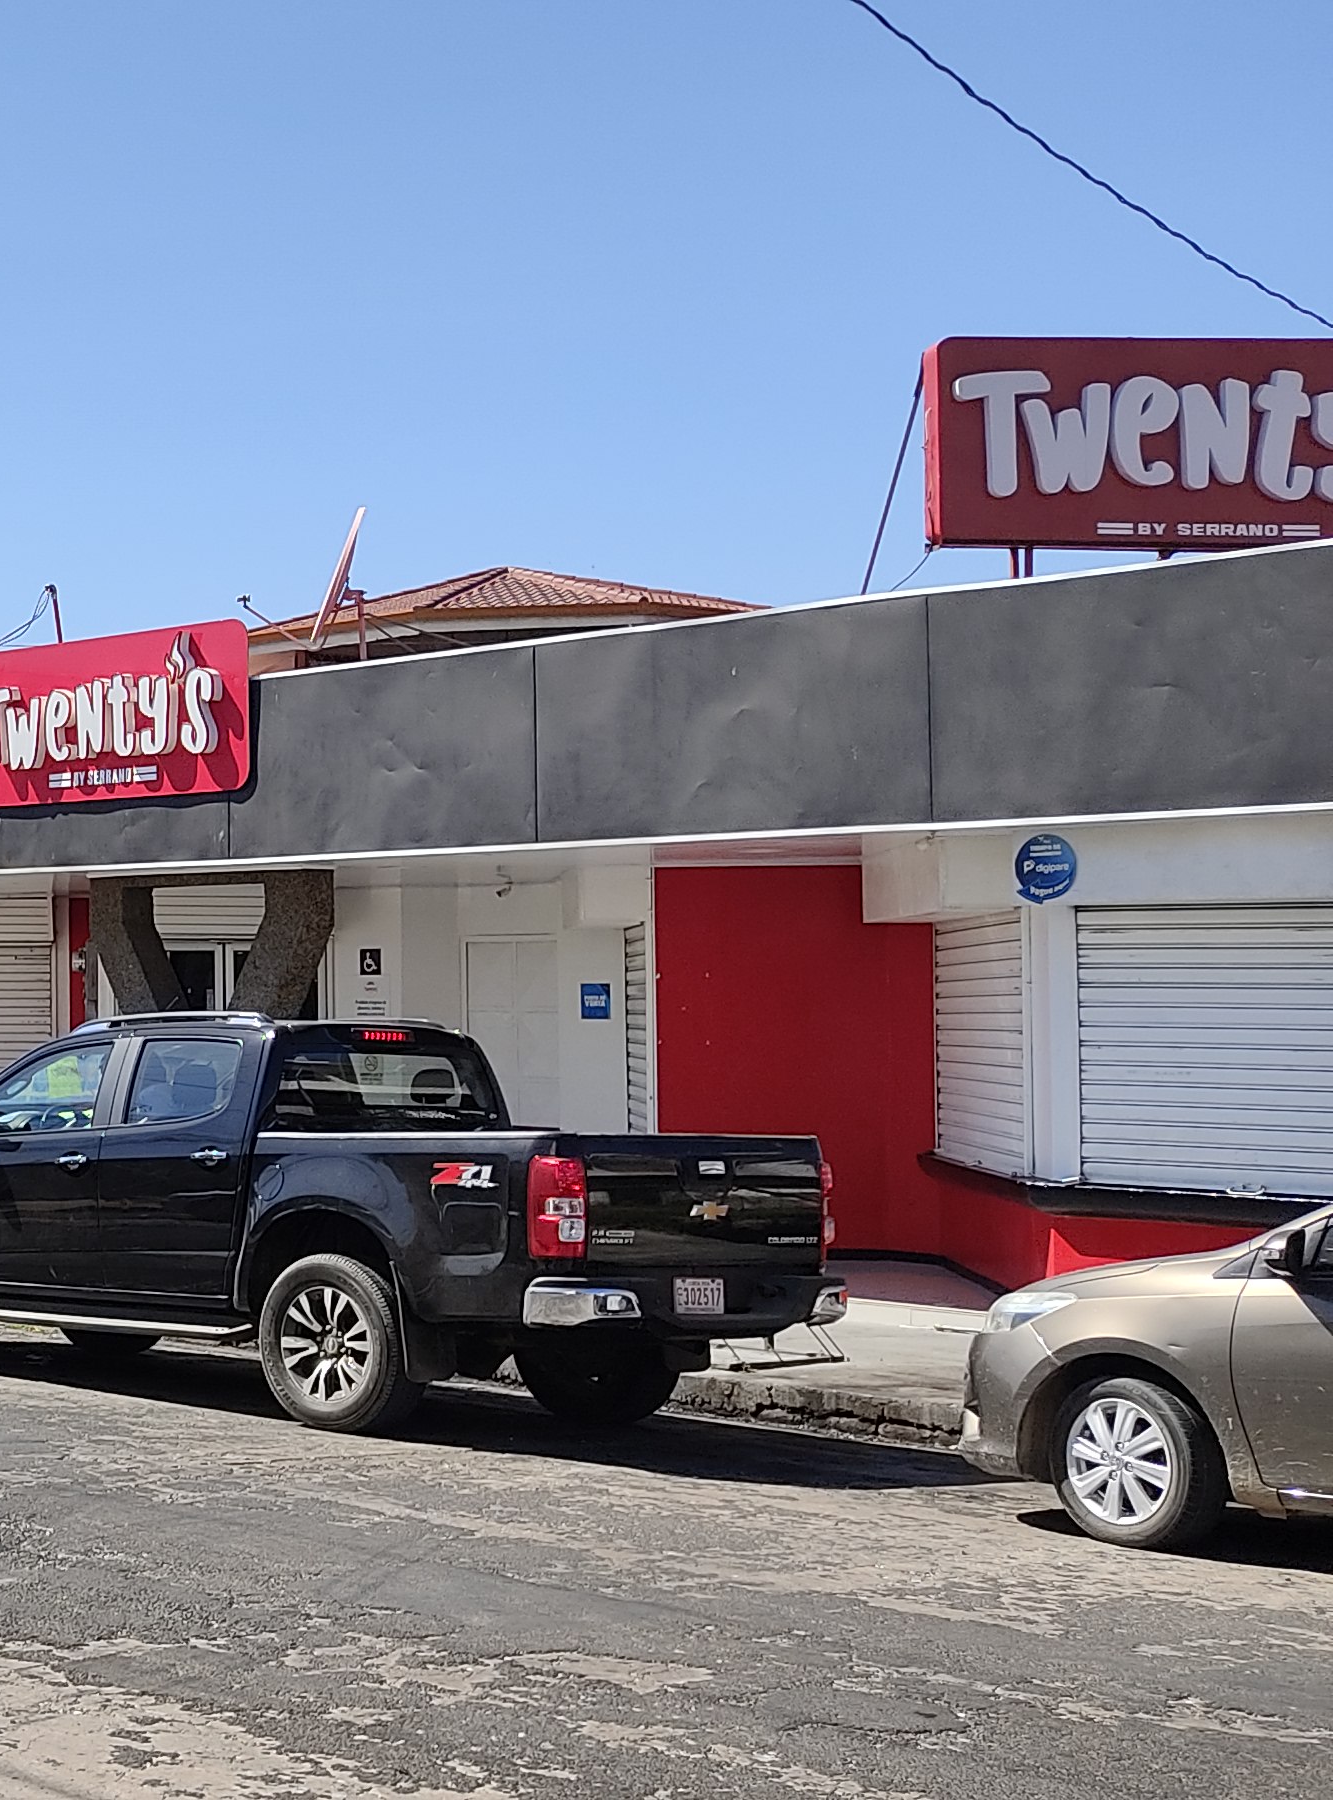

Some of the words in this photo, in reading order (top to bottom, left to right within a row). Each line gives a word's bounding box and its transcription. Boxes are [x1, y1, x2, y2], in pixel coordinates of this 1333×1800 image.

[952, 369, 1333, 501] Twent
[1137, 522, 1166, 536] BY
[1176, 522, 1279, 537] SERRANO
[73, 771, 86, 787] BY
[87, 767, 132, 786] SERRANO
[429, 1162, 493, 1184] Z71
[767, 1236, 805, 1244] COLORADO
[683, 1287, 722, 1307] 302517
